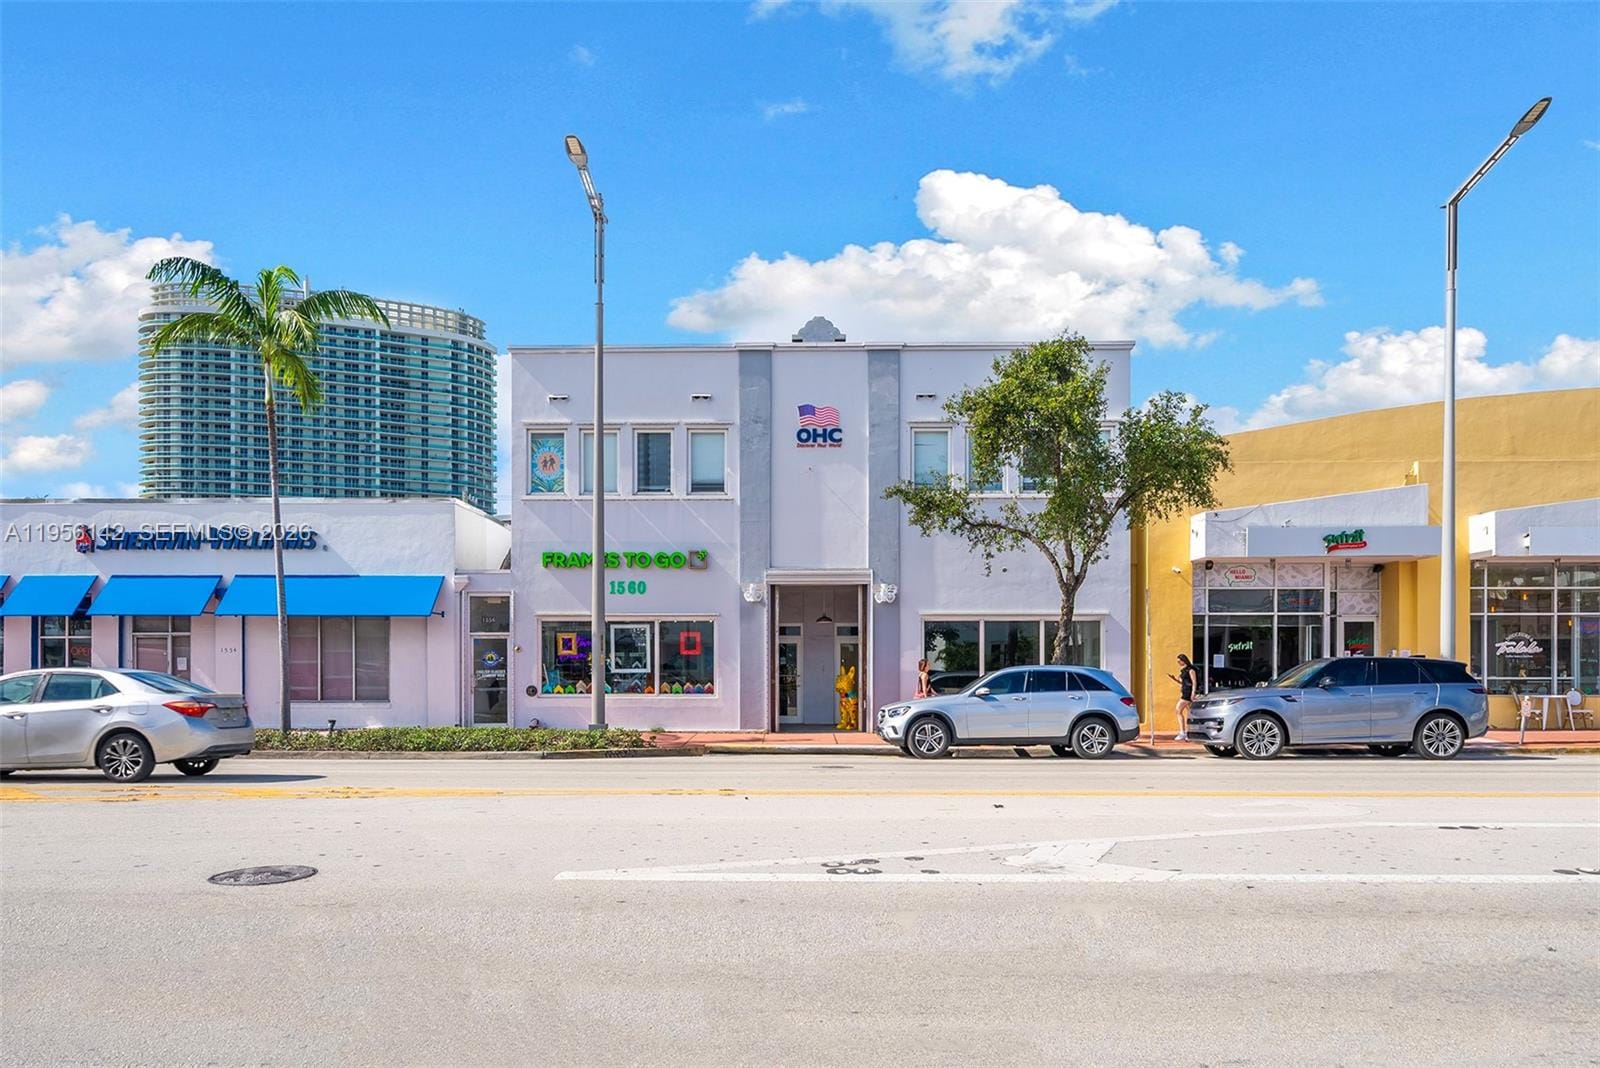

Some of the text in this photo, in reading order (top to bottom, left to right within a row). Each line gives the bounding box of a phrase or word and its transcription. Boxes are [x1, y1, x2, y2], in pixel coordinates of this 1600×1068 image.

[796, 428, 843, 443] OHC
[542, 552, 686, 568] FRAMS TO GO
[609, 581, 647, 595] 1560
